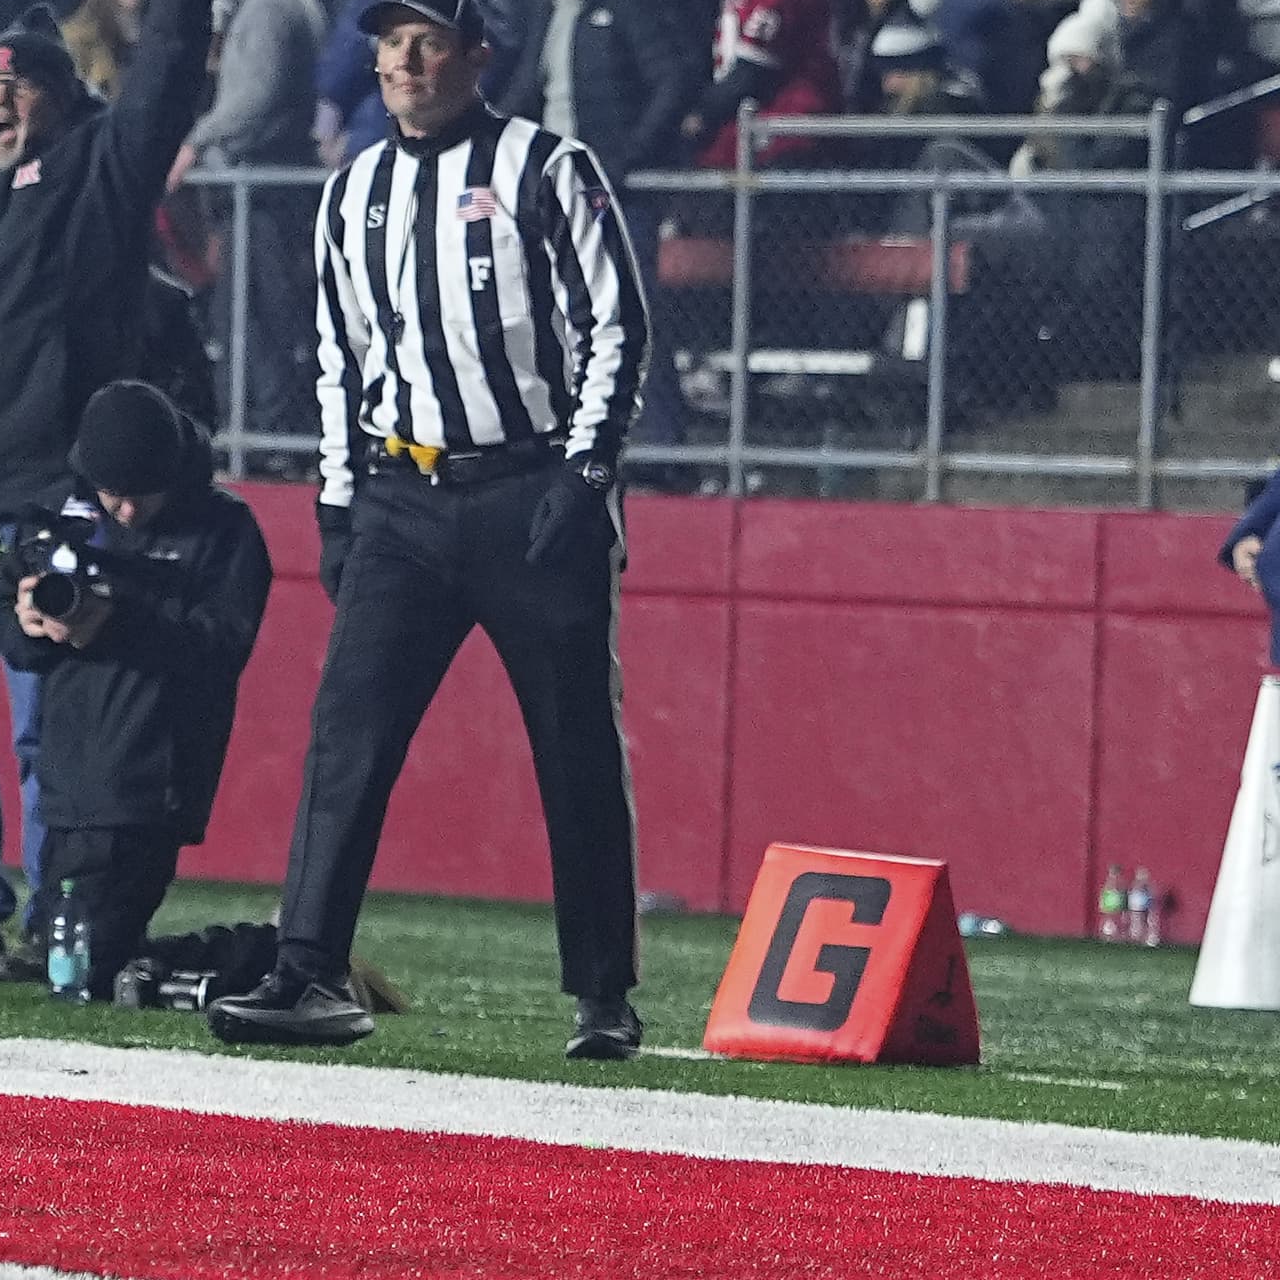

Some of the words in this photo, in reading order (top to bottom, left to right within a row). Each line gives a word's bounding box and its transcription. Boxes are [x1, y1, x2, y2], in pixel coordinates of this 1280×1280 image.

[367, 204, 386, 230] S
[468, 256, 492, 291] F
[747, 871, 893, 1033] G
